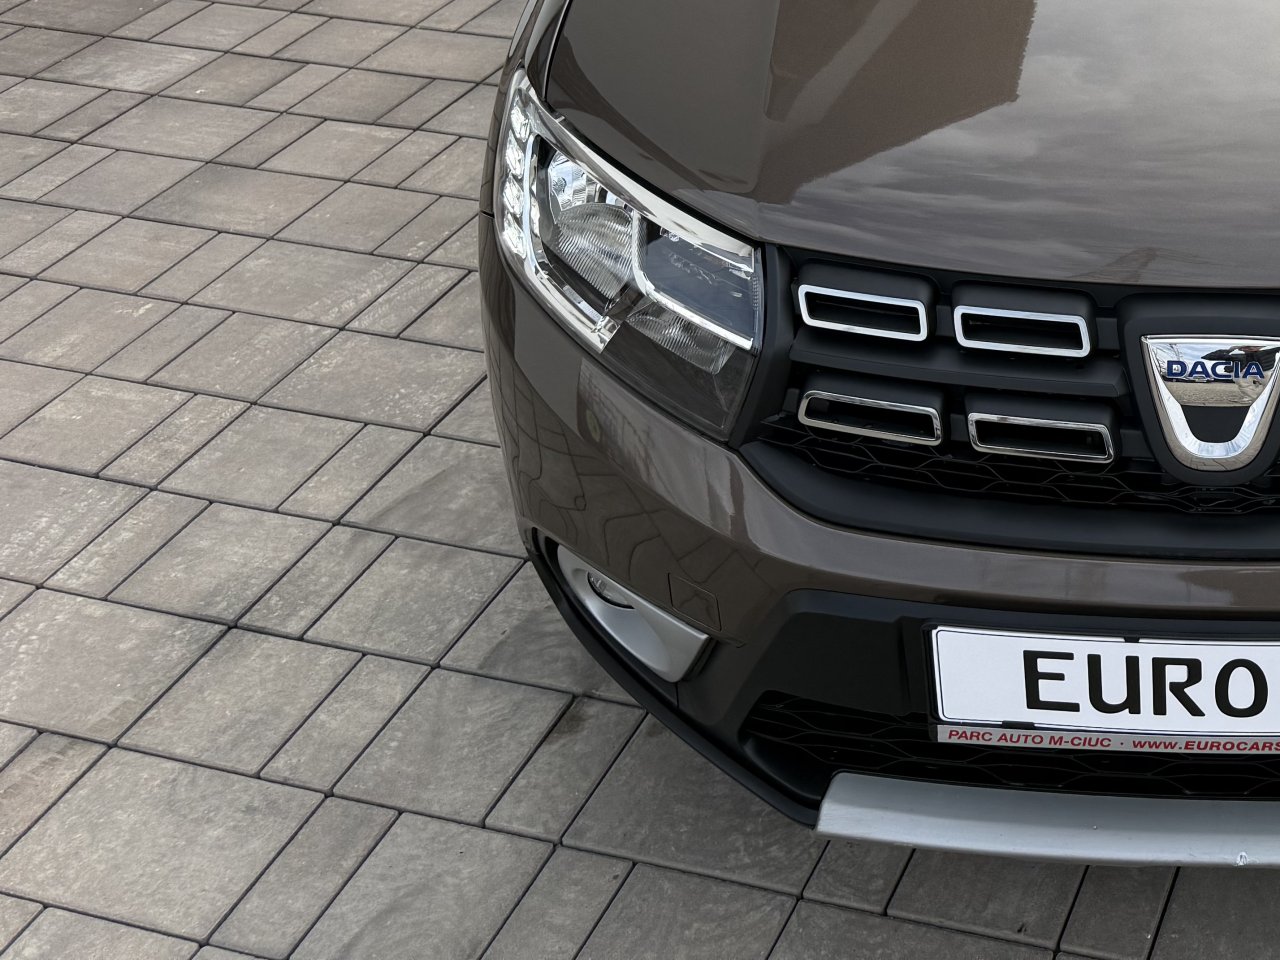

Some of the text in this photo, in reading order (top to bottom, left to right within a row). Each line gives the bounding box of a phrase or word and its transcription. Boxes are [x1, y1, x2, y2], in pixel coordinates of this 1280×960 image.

[1166, 359, 1265, 380] DACIA
[1022, 649, 1269, 718] EURO
[948, 729, 993, 742] PARC
[997, 732, 1044, 745] AUTO
[1048, 735, 1112, 748] M-CIUC
